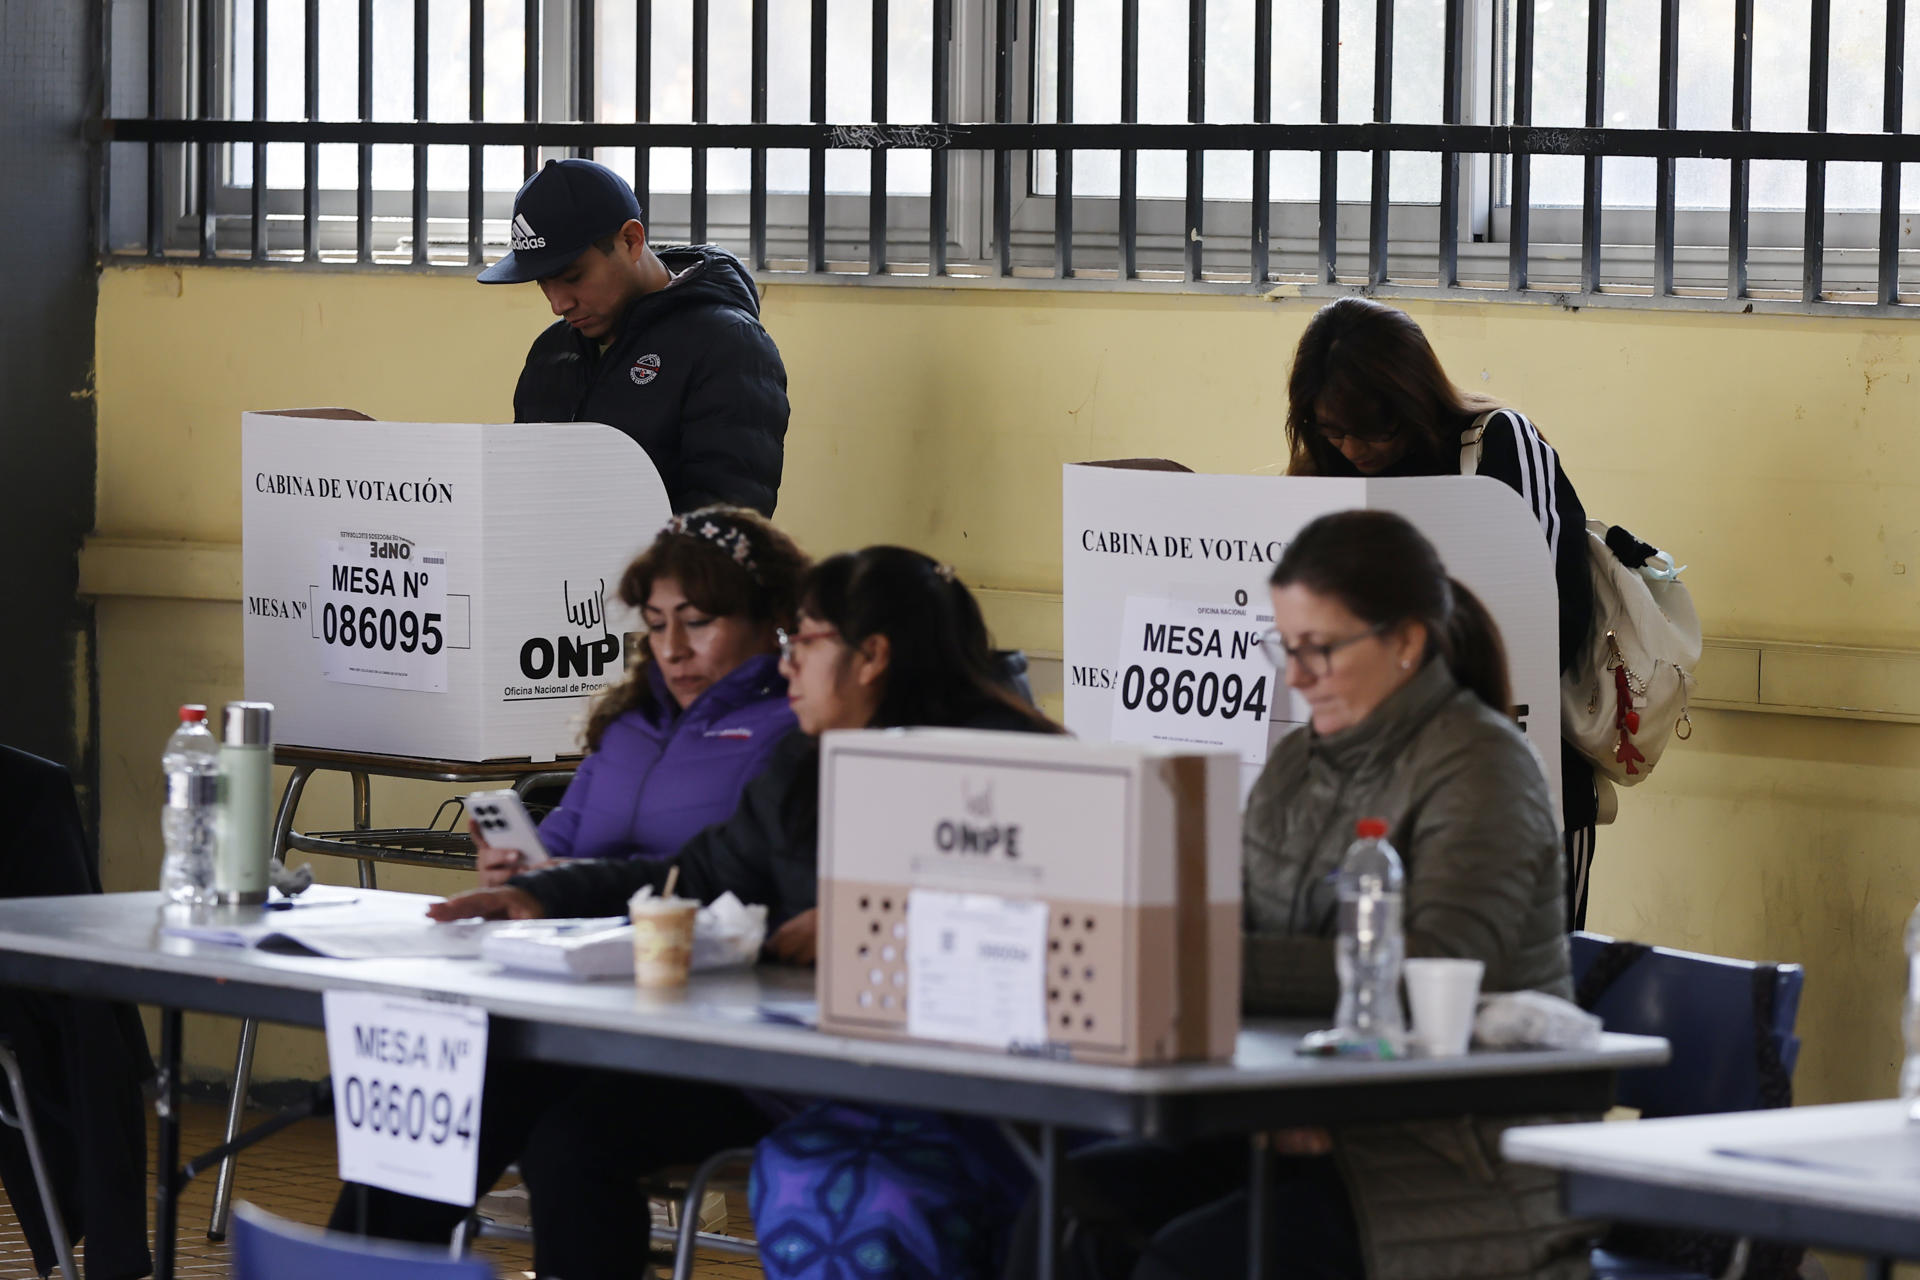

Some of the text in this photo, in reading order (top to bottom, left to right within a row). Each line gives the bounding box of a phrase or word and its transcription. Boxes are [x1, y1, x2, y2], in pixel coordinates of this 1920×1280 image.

[255, 472, 453, 503] CABINA DE VOTACIÓN
[370, 542, 410, 560] ONPE
[1082, 529, 1288, 564] CABINA DE VOTAC
[332, 564, 396, 596] MESA
[249, 596, 290, 619] MESA
[1197, 607, 1219, 615] OFICINA
[323, 602, 443, 655] 086095
[1143, 623, 1222, 658] MESA
[520, 632, 626, 680] ONP
[504, 686, 532, 696] Oficina
[534, 684, 567, 694] Nacional
[570, 684, 579, 692] de
[1122, 664, 1267, 721] 086094
[354, 1025, 429, 1068] MESA
[346, 1076, 473, 1149] 086094
